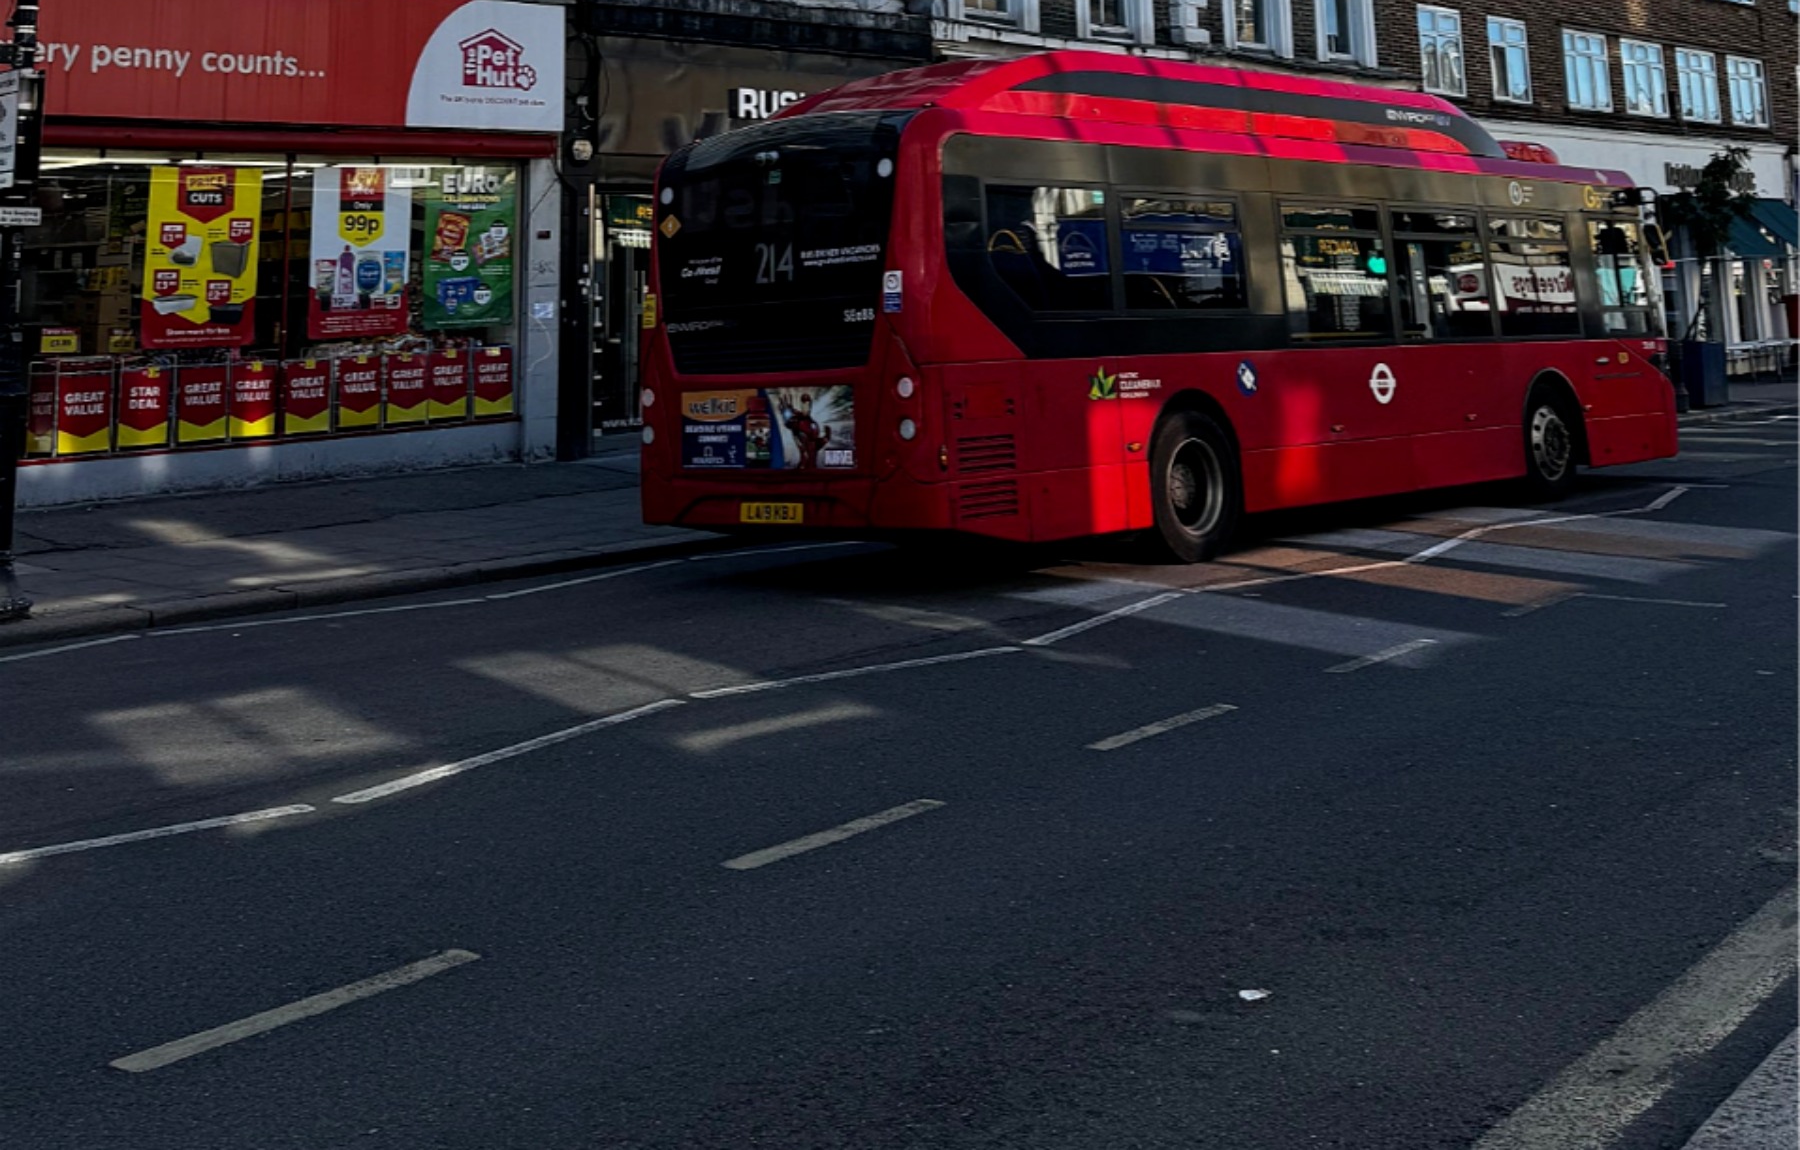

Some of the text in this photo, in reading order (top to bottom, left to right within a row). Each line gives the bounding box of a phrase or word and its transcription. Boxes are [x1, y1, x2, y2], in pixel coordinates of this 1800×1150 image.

[33, 41, 326, 77] ery penny counts...
[477, 44, 516, 66] Pet
[477, 64, 516, 86] Hut
[737, 87, 807, 120] RUS
[189, 192, 223, 204] CUTS
[344, 214, 380, 236] 99p
[755, 242, 794, 285] 214
[290, 376, 326, 388] GREAT
[344, 370, 377, 382] GREAT
[184, 382, 222, 394] GREAT
[235, 379, 272, 390] GREAT
[344, 382, 377, 393] VALUE
[64, 391, 106, 404] GREAT
[129, 386, 161, 397] STAR
[235, 391, 271, 402] VALUE
[290, 387, 325, 399] VALUE
[129, 398, 160, 410] DEAL
[184, 394, 221, 406] VALUE
[64, 403, 105, 416] VALUE
